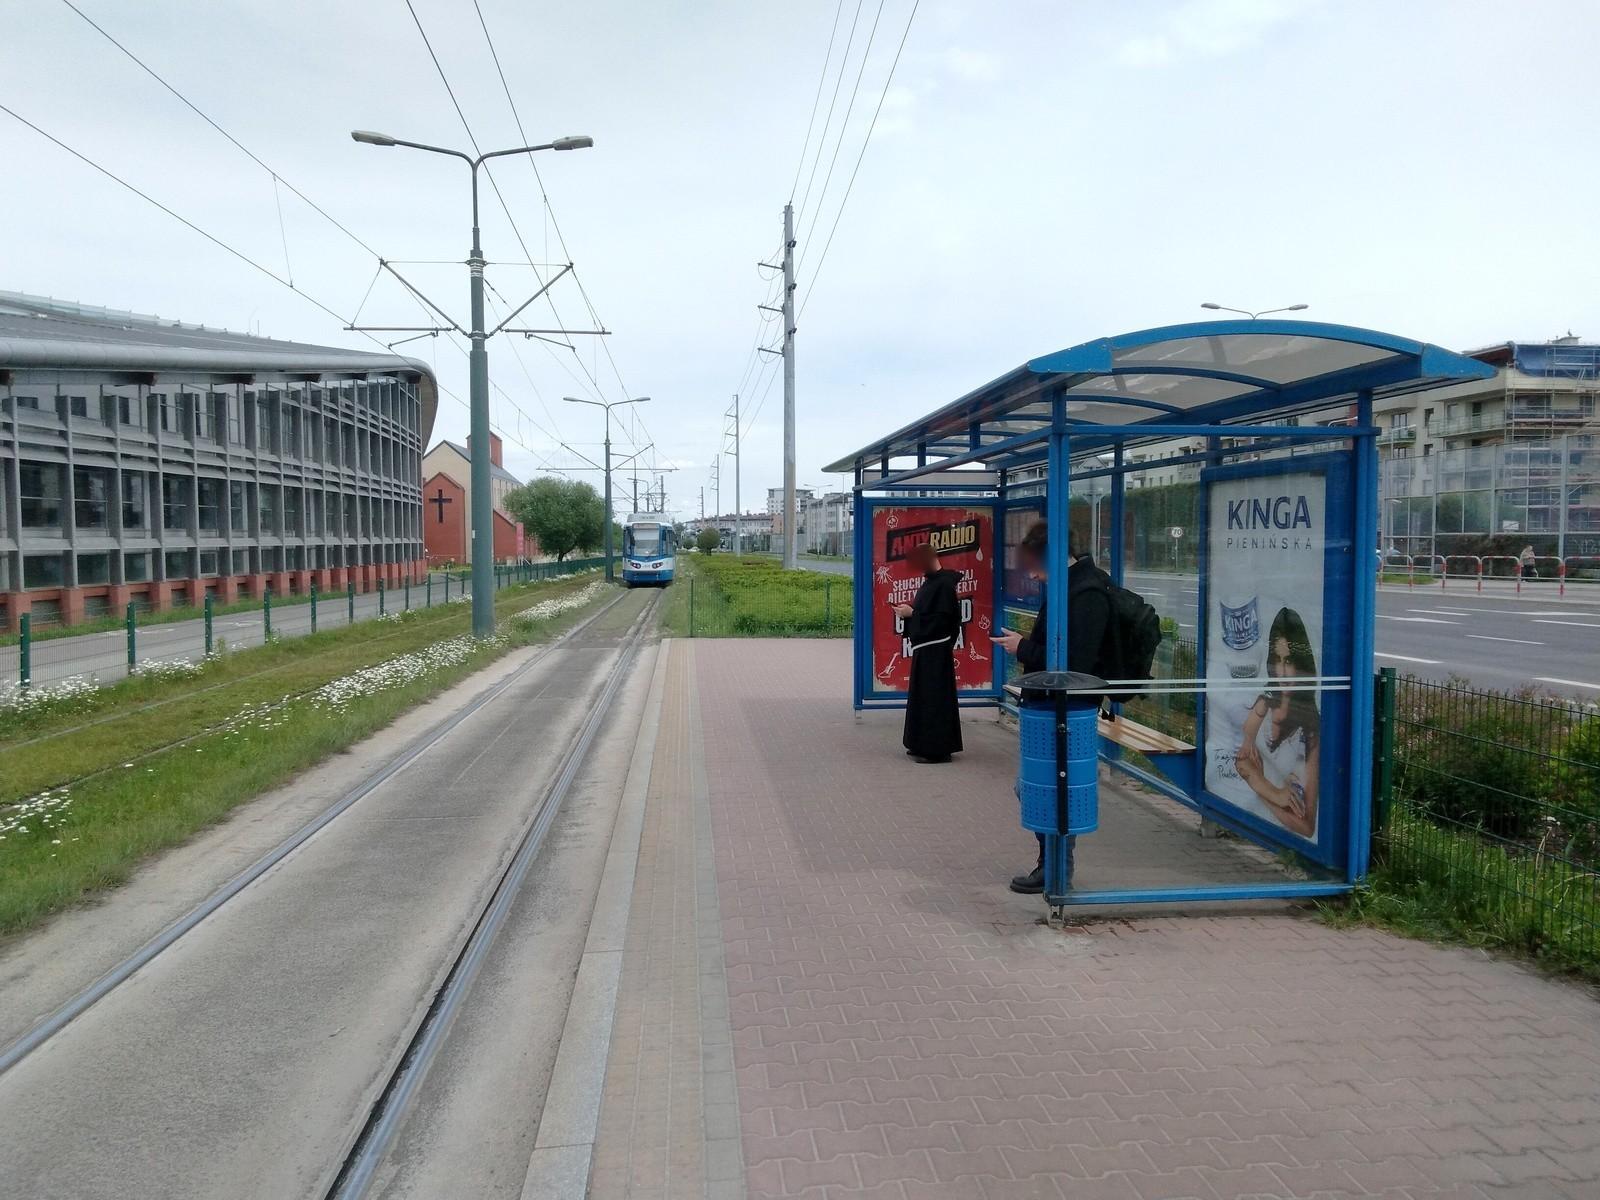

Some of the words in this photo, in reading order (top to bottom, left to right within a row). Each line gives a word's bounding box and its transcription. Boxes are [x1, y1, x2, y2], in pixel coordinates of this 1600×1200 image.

[1227, 496, 1312, 530] KINGA
[1226, 533, 1312, 550] PIENIŃSKA
[893, 576, 926, 592] SŁUCHA
[956, 580, 978, 594] ERTY
[1224, 608, 1258, 632] KINGA
